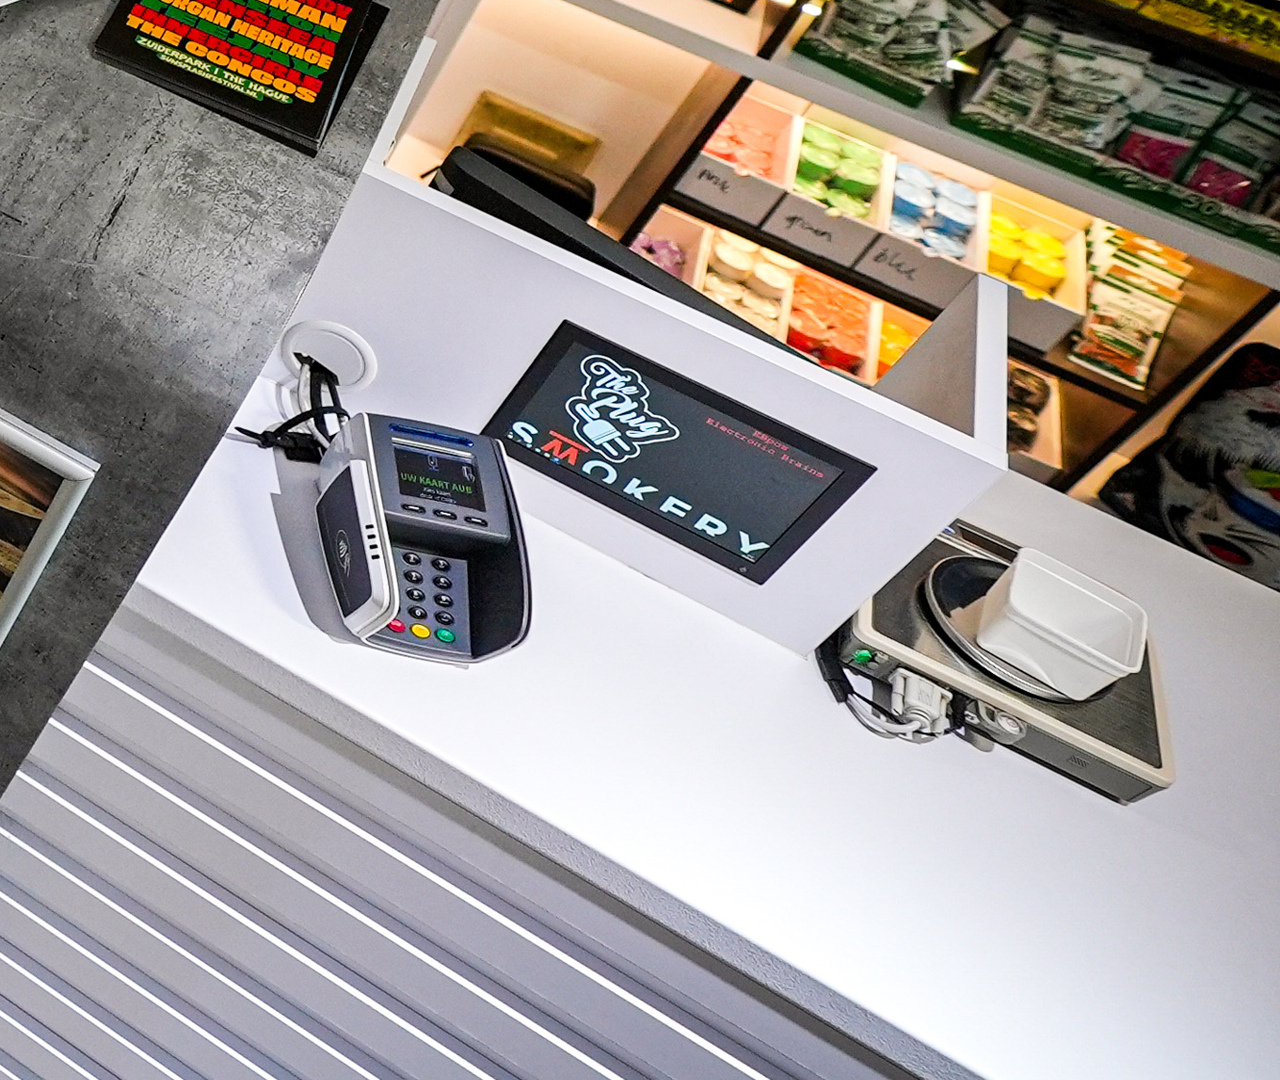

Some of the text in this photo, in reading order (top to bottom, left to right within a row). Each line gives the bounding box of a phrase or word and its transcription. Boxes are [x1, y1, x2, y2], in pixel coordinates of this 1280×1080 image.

[126, 13, 317, 103] THE CONGOS
[231, 18, 335, 69] HERITAGE
[137, 36, 290, 103] ZUIDERPARK THE HAGUE
[590, 362, 640, 395] The
[591, 389, 670, 439] Plug
[706, 418, 824, 478] Electronic Brains
[400, 472, 472, 494] UW KAART AUB
